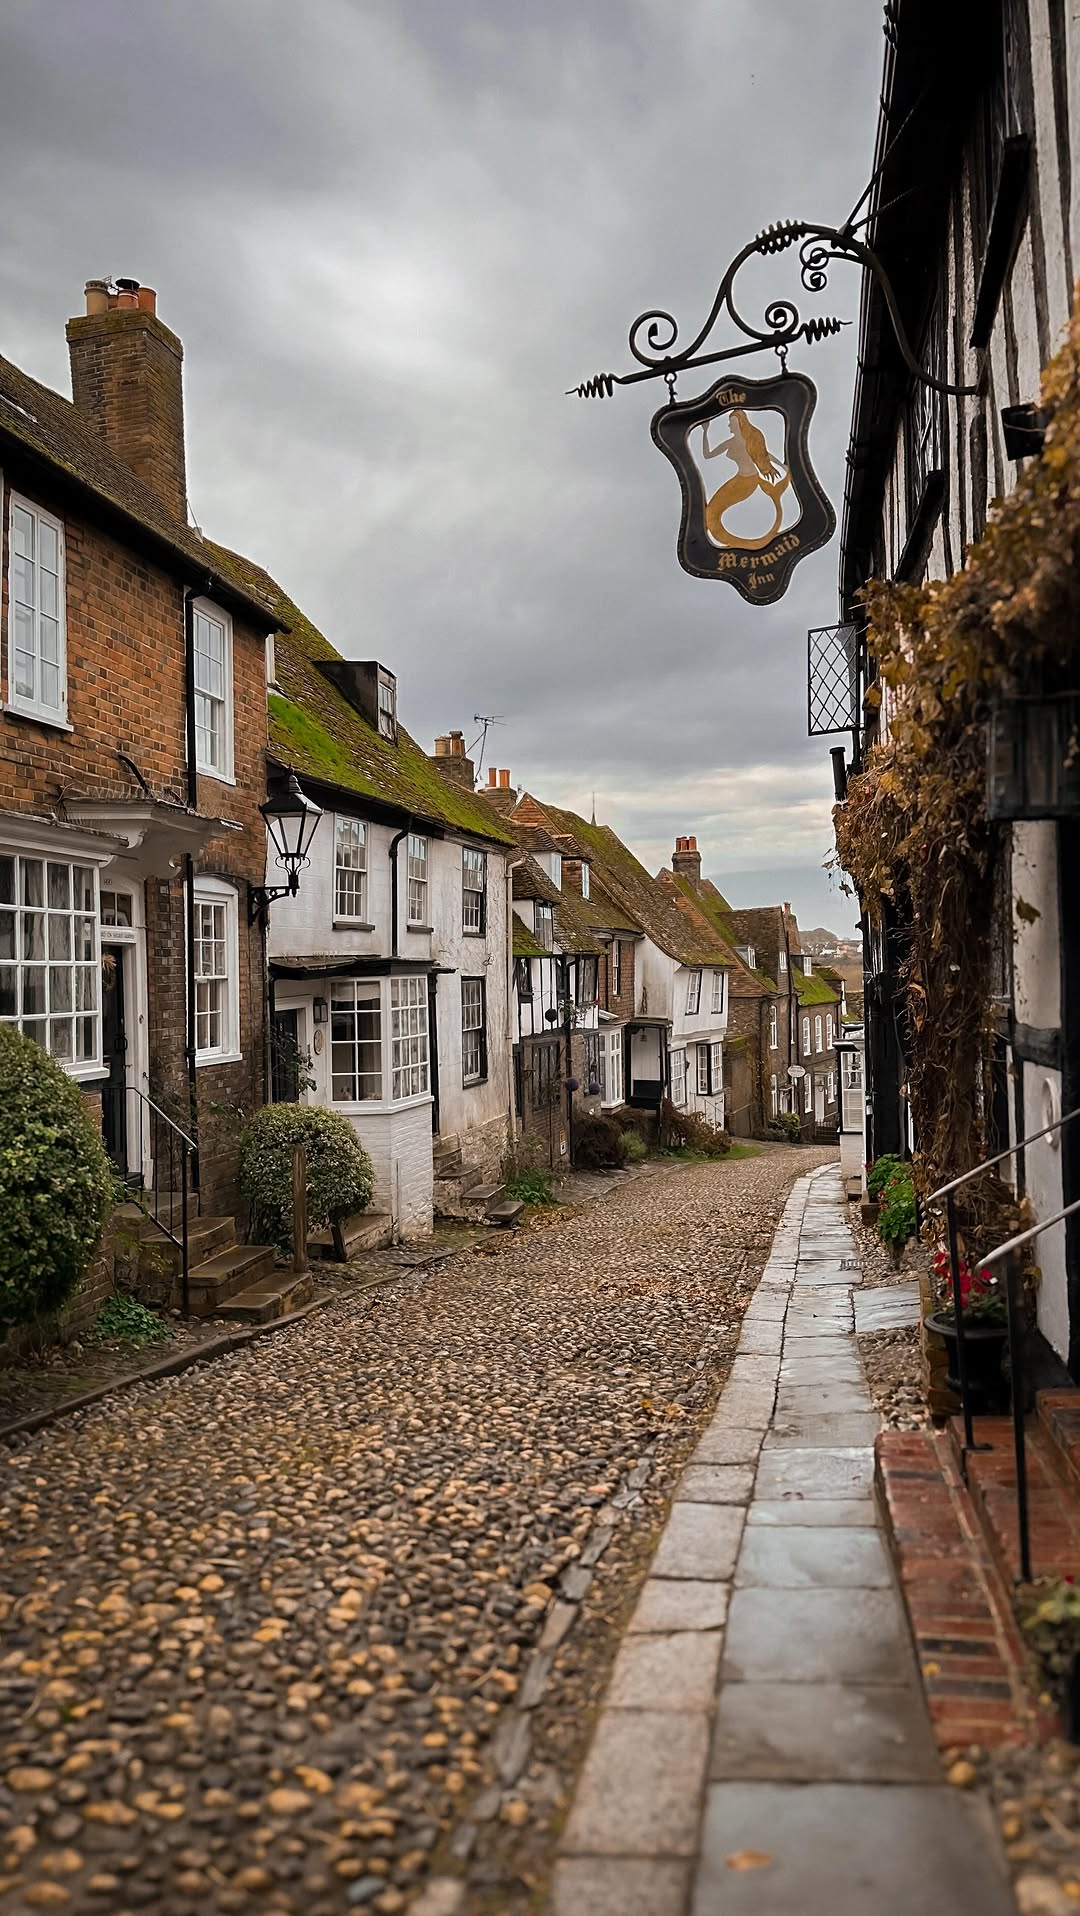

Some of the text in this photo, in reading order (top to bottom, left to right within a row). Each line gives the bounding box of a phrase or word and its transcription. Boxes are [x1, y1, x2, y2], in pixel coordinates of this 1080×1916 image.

[716, 388, 746, 406] The
[716, 534, 800, 571] Mermaid
[747, 571, 775, 590] Inn
